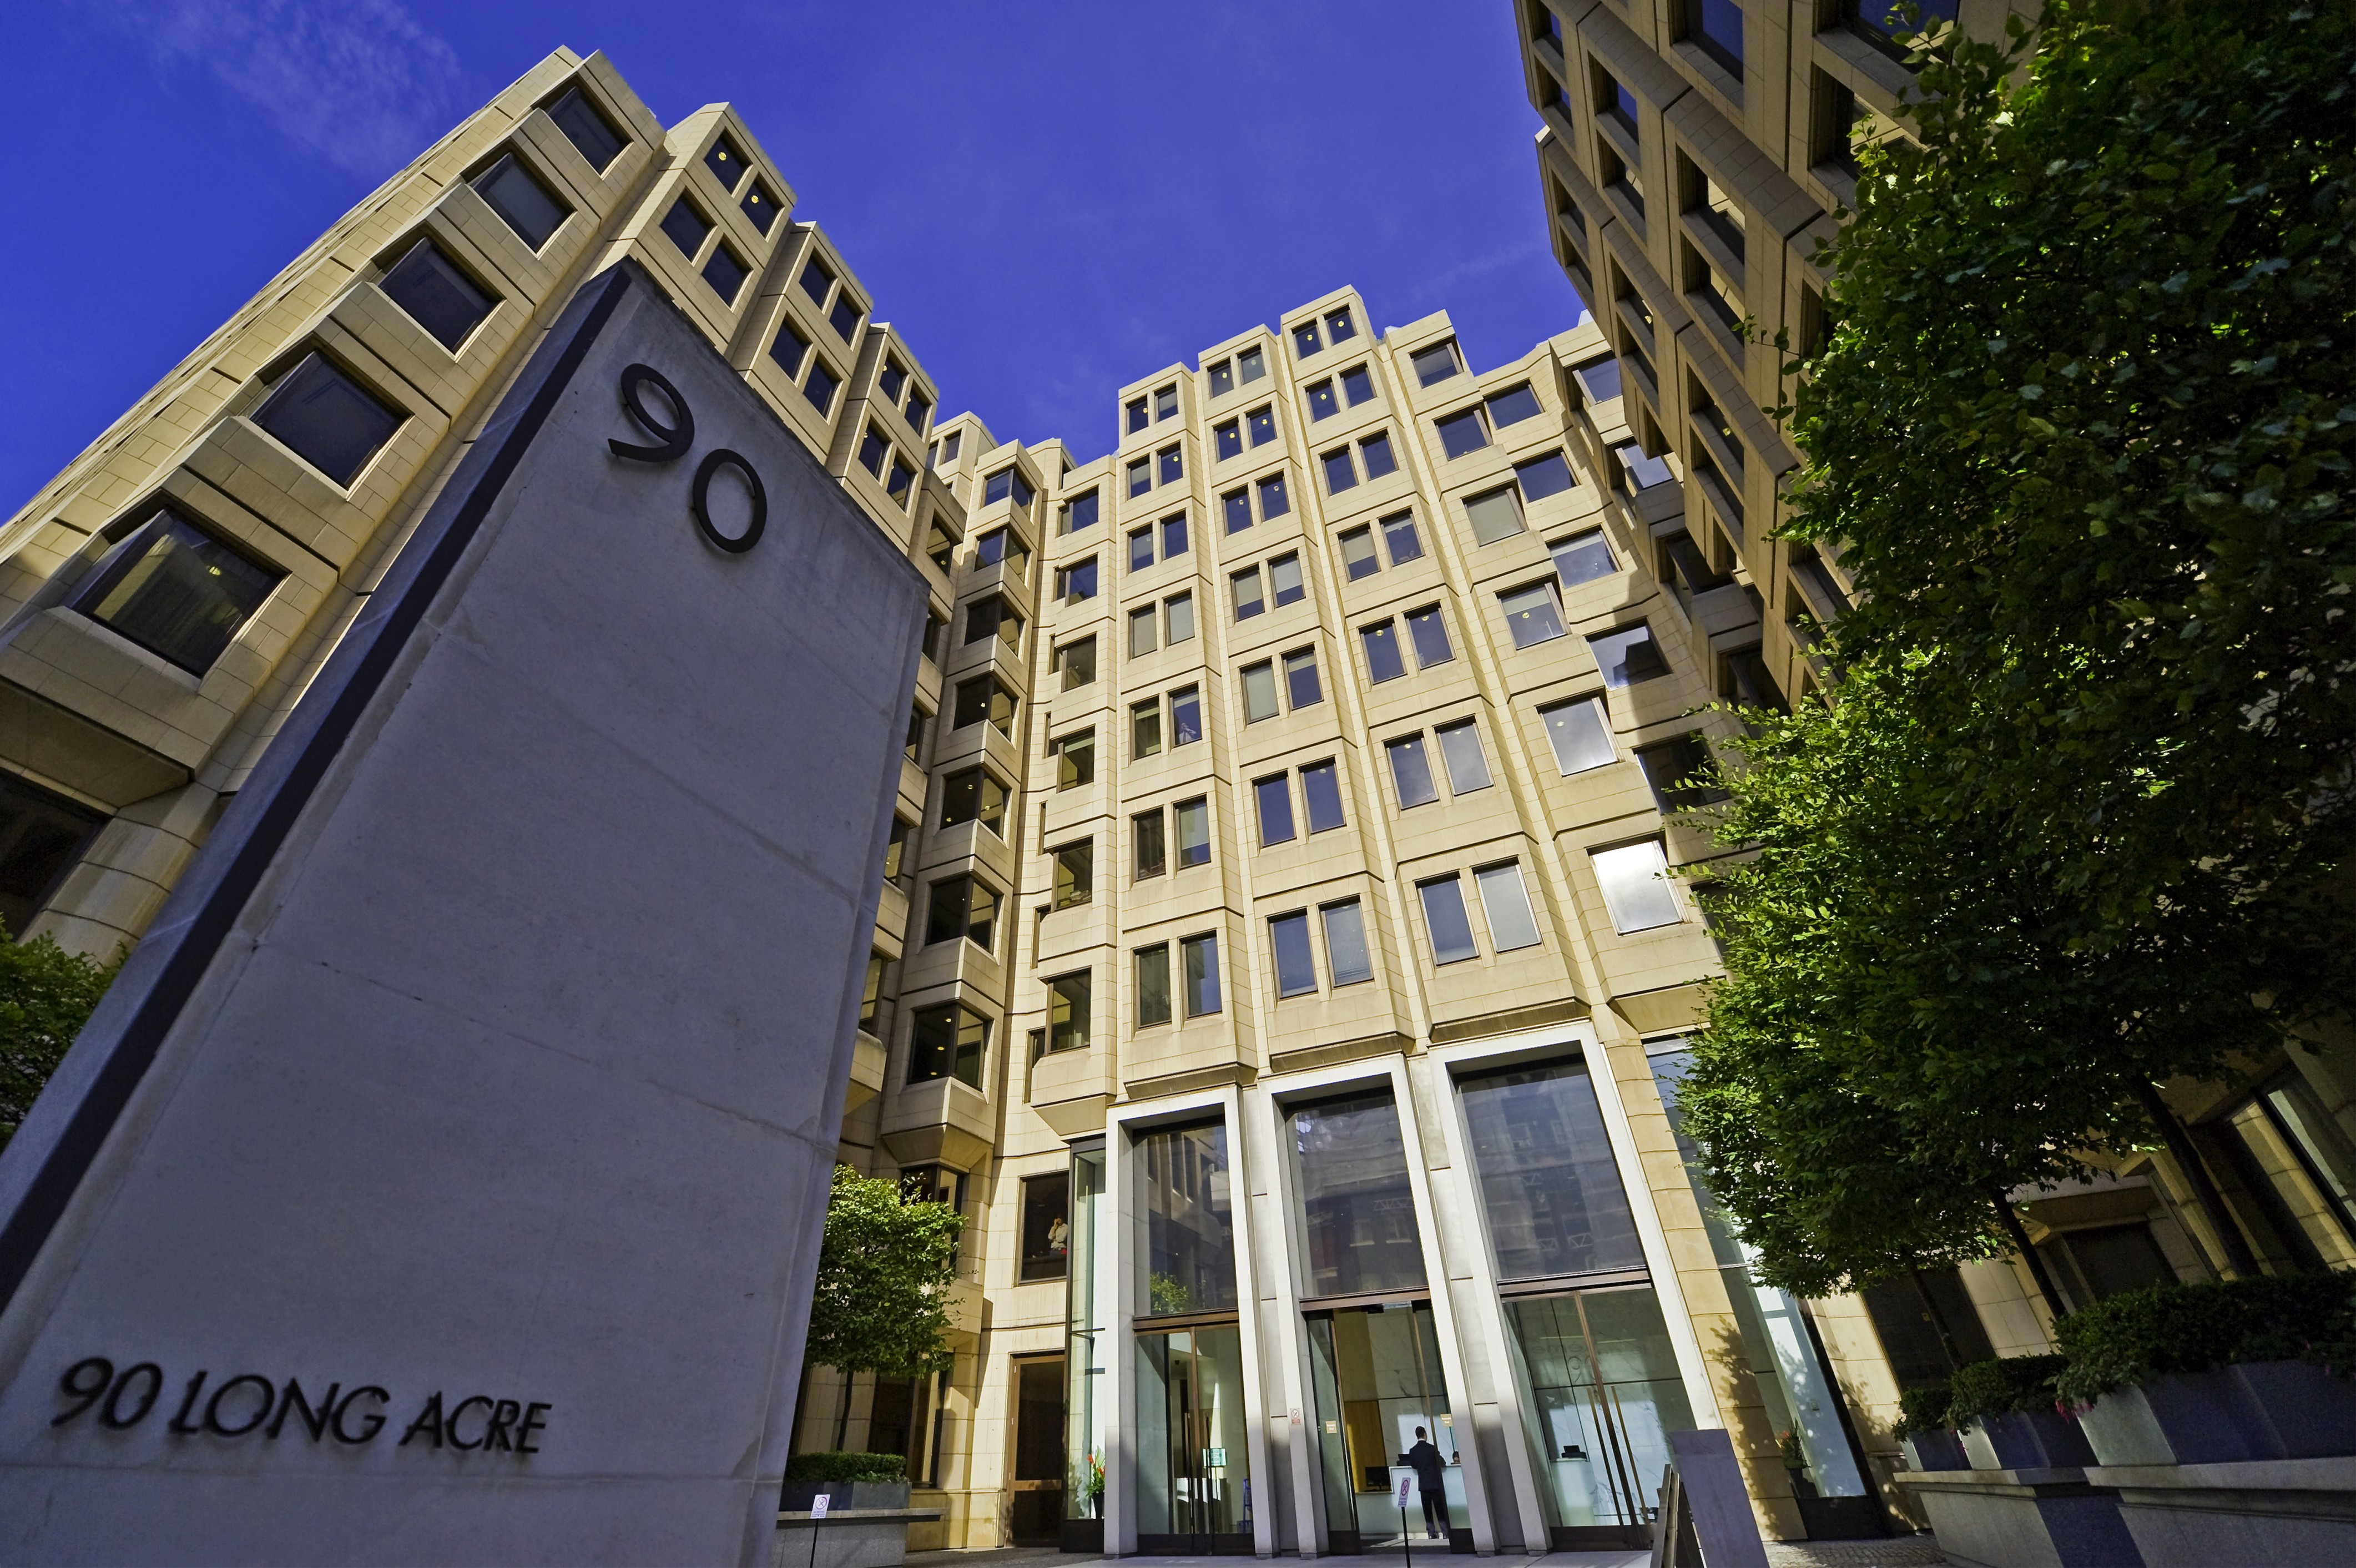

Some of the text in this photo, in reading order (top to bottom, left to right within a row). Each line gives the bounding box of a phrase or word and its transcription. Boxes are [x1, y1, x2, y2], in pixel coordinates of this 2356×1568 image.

[607, 362, 768, 554] 90
[51, 1356, 552, 1453] 90 LONG ACRE
